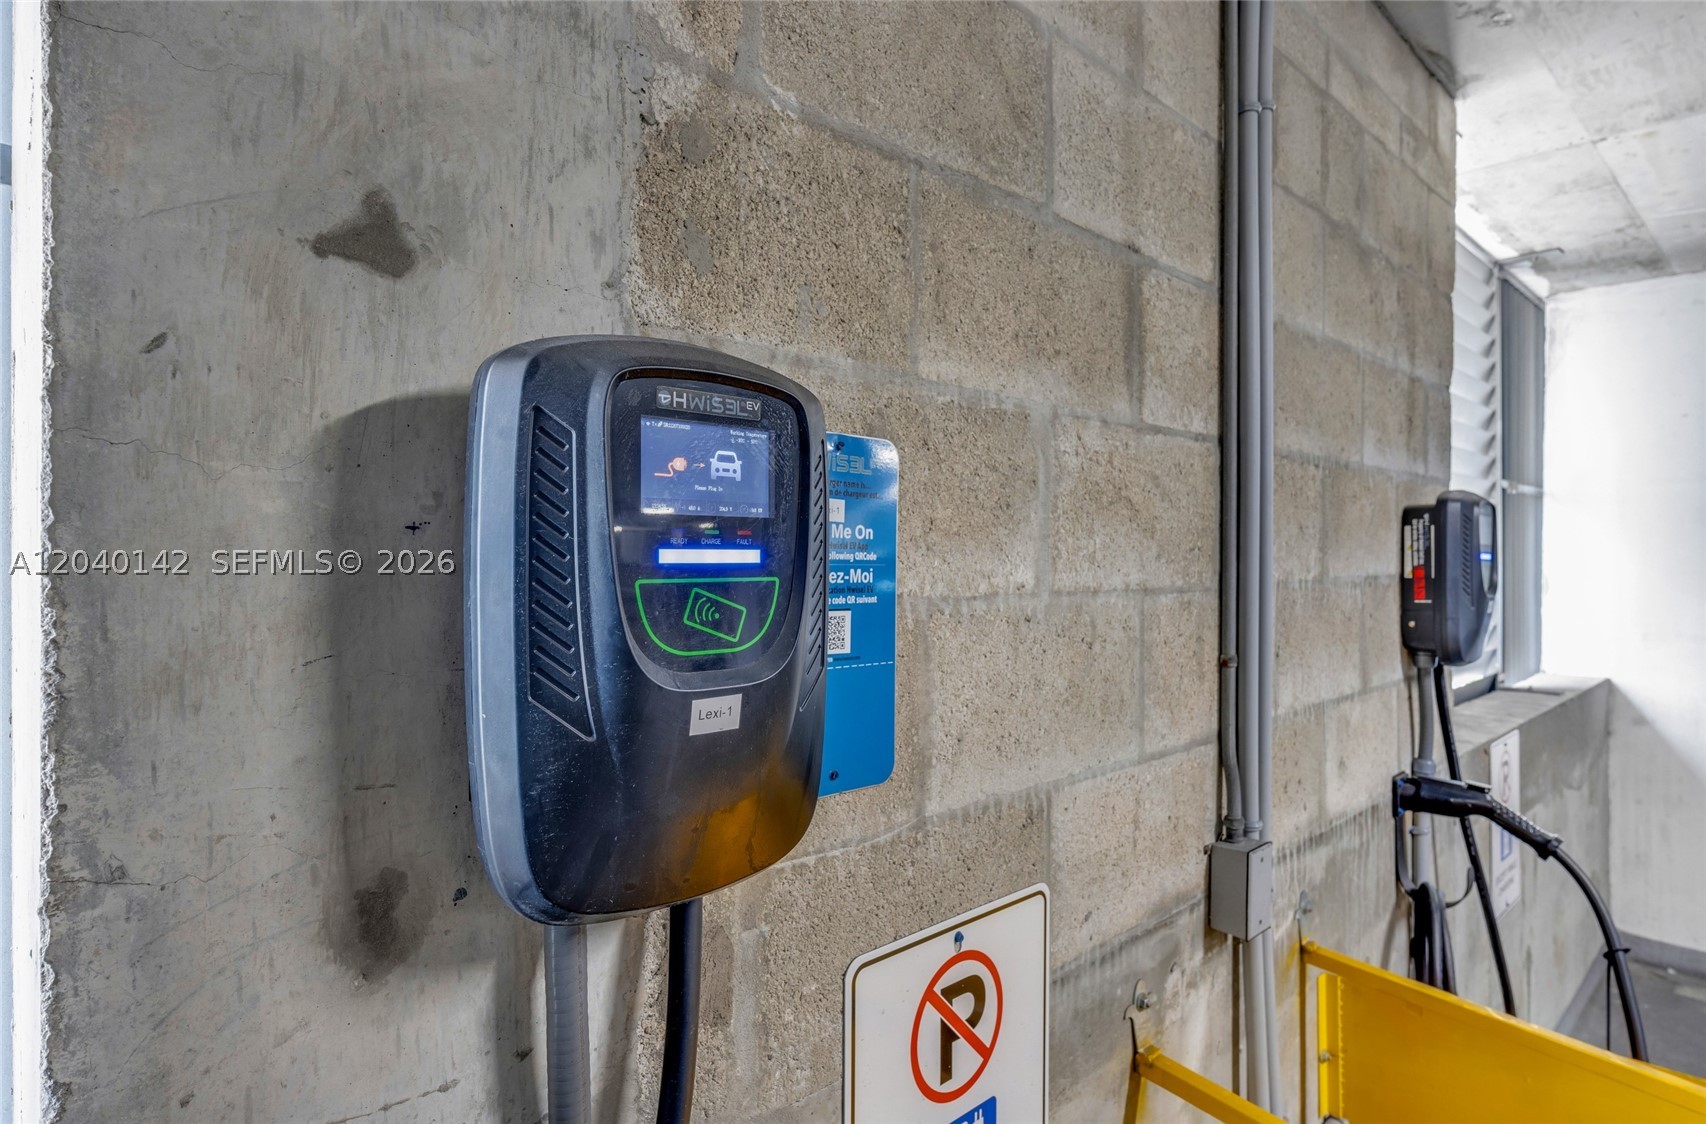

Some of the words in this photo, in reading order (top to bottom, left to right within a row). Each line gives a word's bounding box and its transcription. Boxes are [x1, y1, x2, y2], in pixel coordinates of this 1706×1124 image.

[831, 523, 852, 539] Me
[854, 524, 874, 540] On
[670, 537, 688, 545] READY
[855, 552, 877, 560] QRCode
[847, 585, 865, 593] Hwisel
[867, 585, 873, 593] EV
[832, 595, 846, 604] code
[847, 595, 855, 604] QR
[856, 595, 877, 603] suivant
[698, 706, 733, 721] Lexi-1
